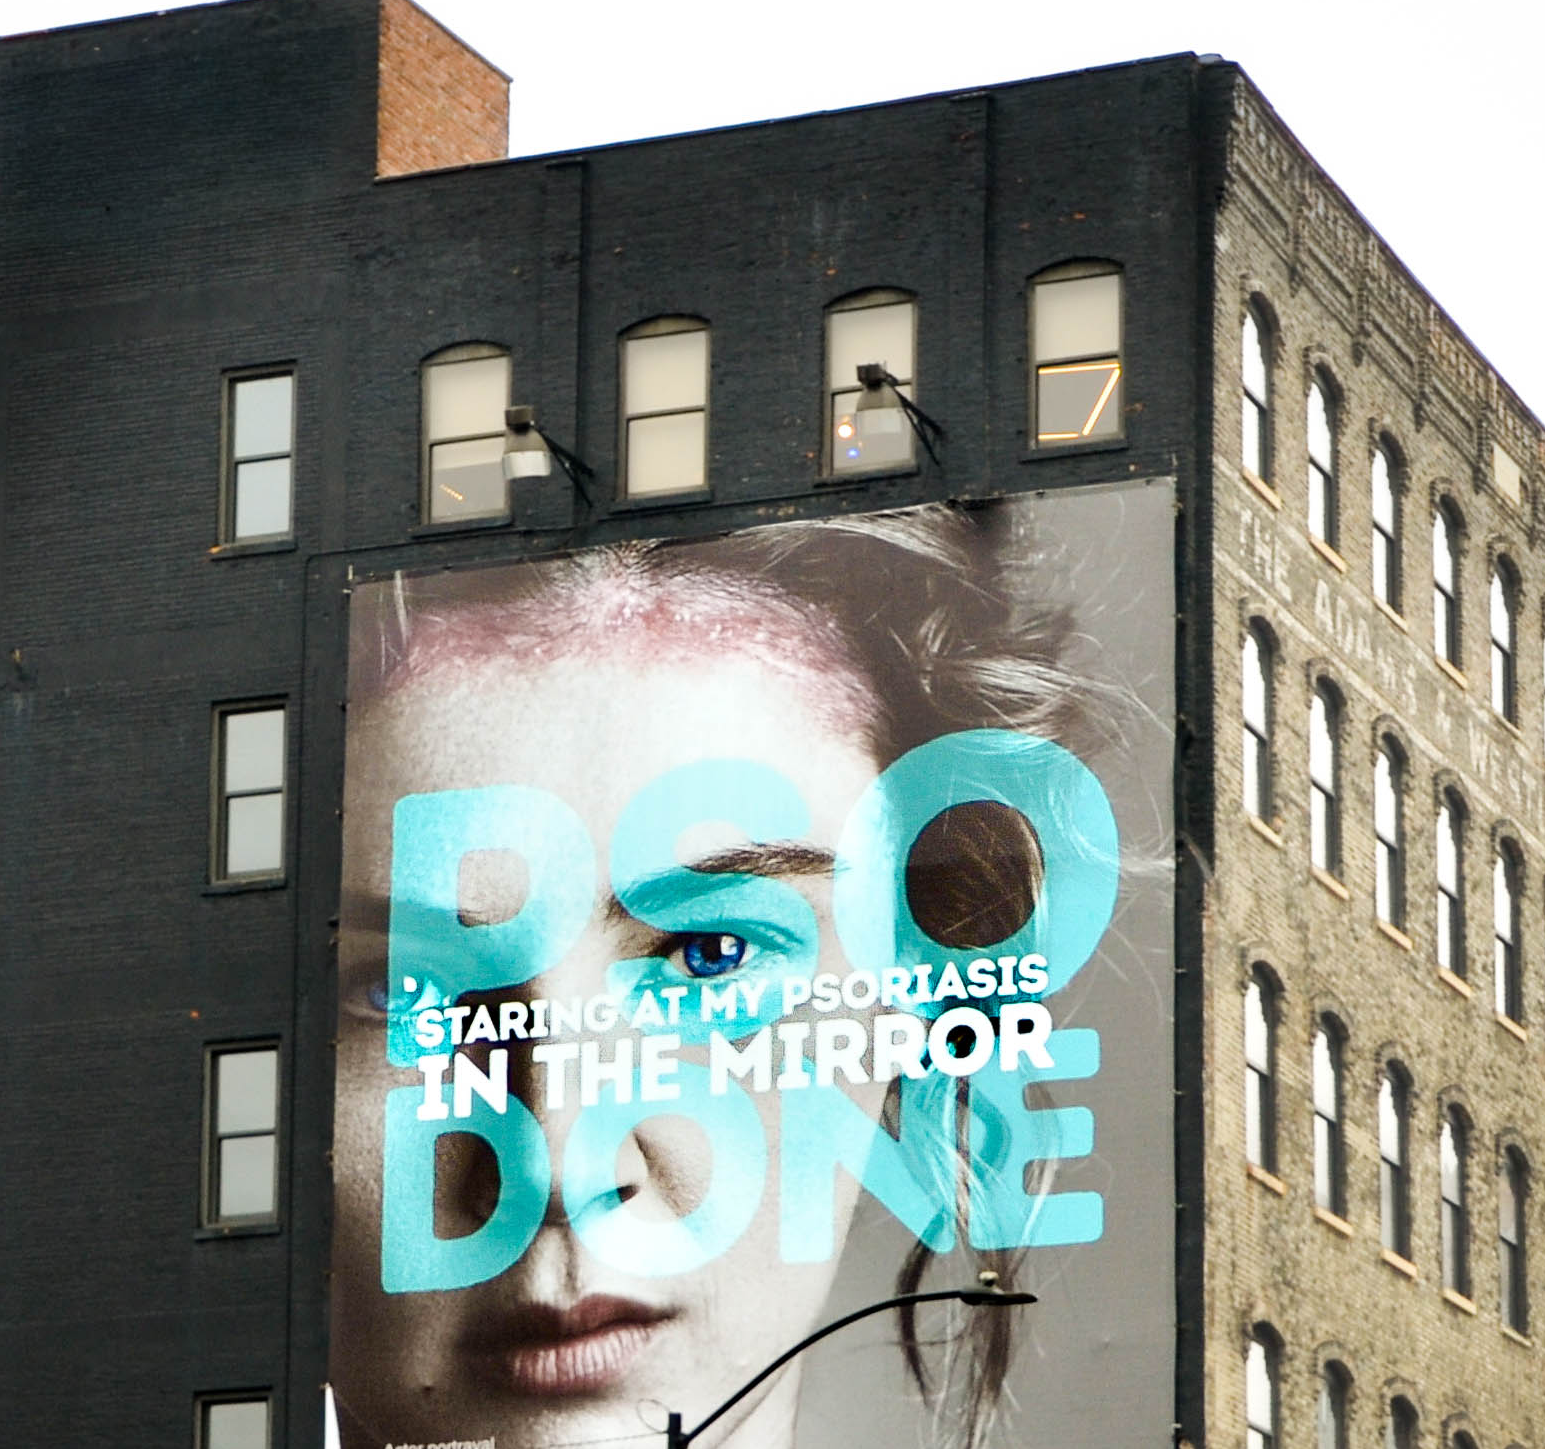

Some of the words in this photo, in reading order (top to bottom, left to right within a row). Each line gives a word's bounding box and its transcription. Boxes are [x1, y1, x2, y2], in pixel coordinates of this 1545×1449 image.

[388, 728, 1120, 1068] PSO
[415, 993, 619, 1048] STARING
[633, 987, 690, 1029] AT
[700, 979, 770, 1023] MY
[783, 953, 1051, 1016] PSORIASIS
[417, 1048, 509, 1121] IN
[532, 1033, 683, 1112] THE
[709, 1002, 1056, 1098] MIRROR
[381, 1026, 1105, 1295] DONE
